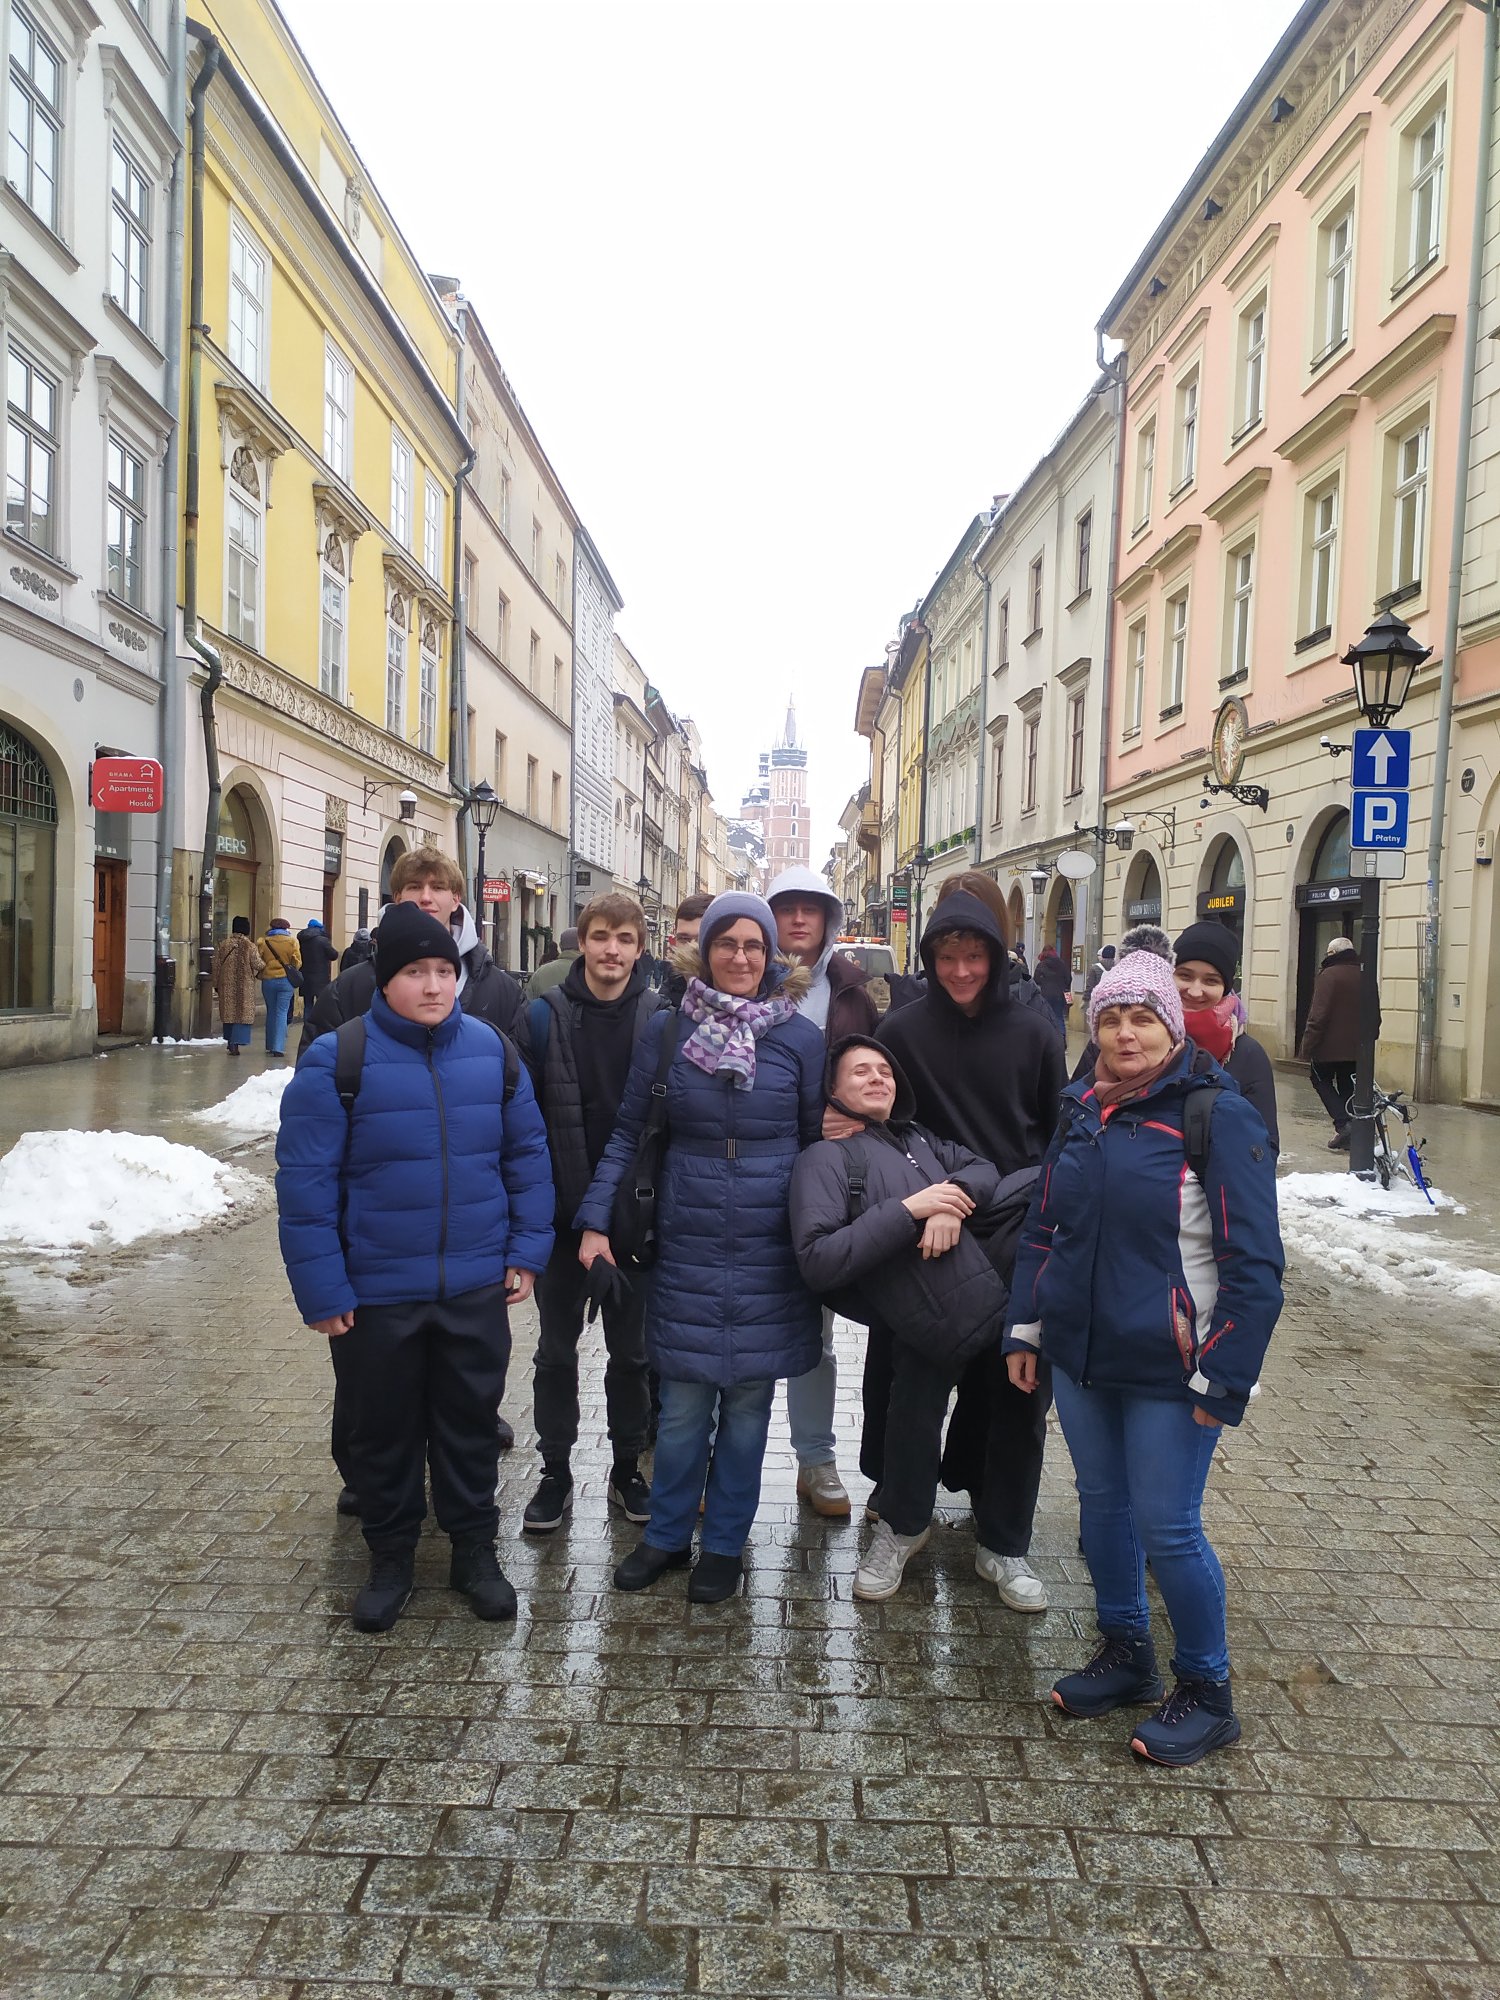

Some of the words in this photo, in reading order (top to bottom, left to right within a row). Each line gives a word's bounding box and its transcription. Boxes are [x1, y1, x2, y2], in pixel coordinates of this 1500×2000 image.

[108, 784, 155, 793] Apartments
[129, 799, 155, 808] Hostel
[1363, 797, 1398, 842] P
[1375, 834, 1401, 844] Płatny
[483, 887, 509, 895] KEBAB
[1341, 888, 1359, 896] POTTERY
[1207, 895, 1235, 909] JUBILER
